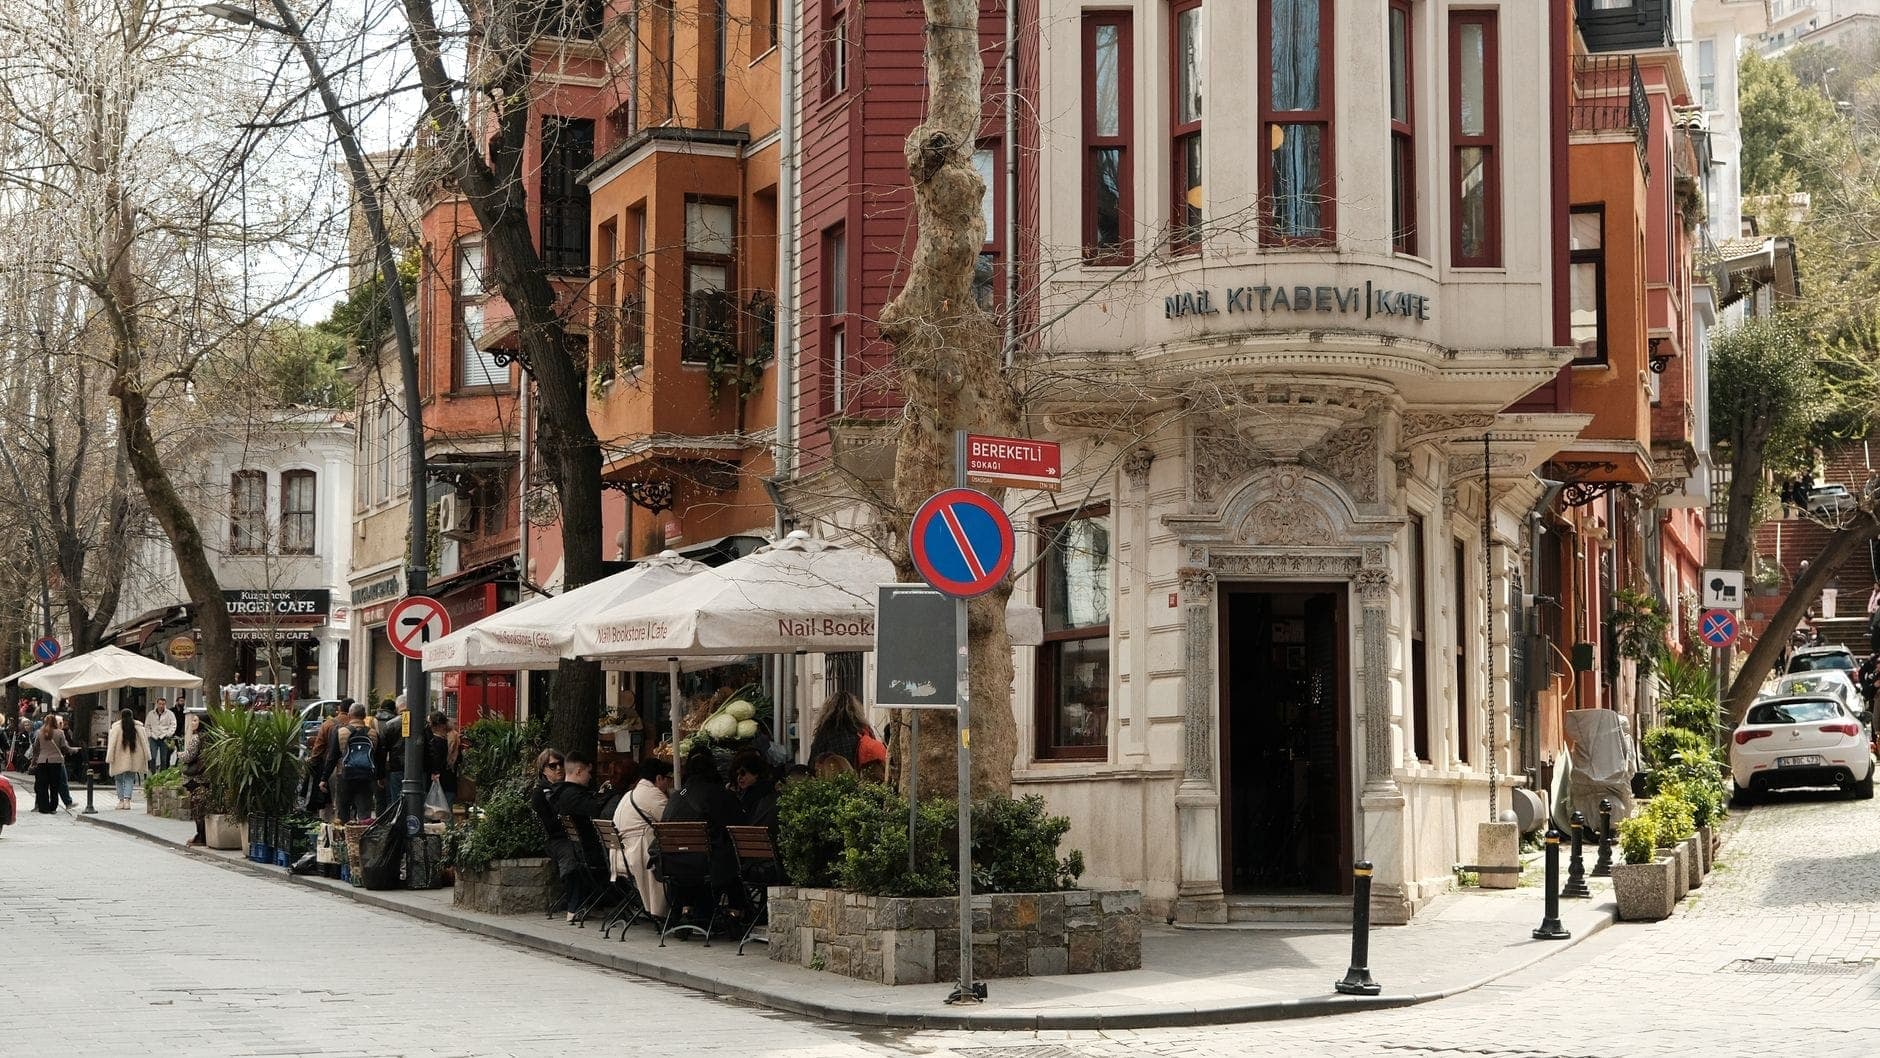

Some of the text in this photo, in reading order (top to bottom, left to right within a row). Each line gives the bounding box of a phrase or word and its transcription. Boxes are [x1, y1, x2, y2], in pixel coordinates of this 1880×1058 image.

[1374, 289, 1431, 320] KAFE
[972, 442, 1042, 462] BEREKETLİ
[971, 460, 1001, 470] SOKAĞI
[277, 601, 316, 613] CAFE
[286, 632, 310, 640] CAFE
[612, 624, 646, 643] Bookstore
[651, 621, 668, 639] Cafe
[778, 618, 815, 636] Nail
